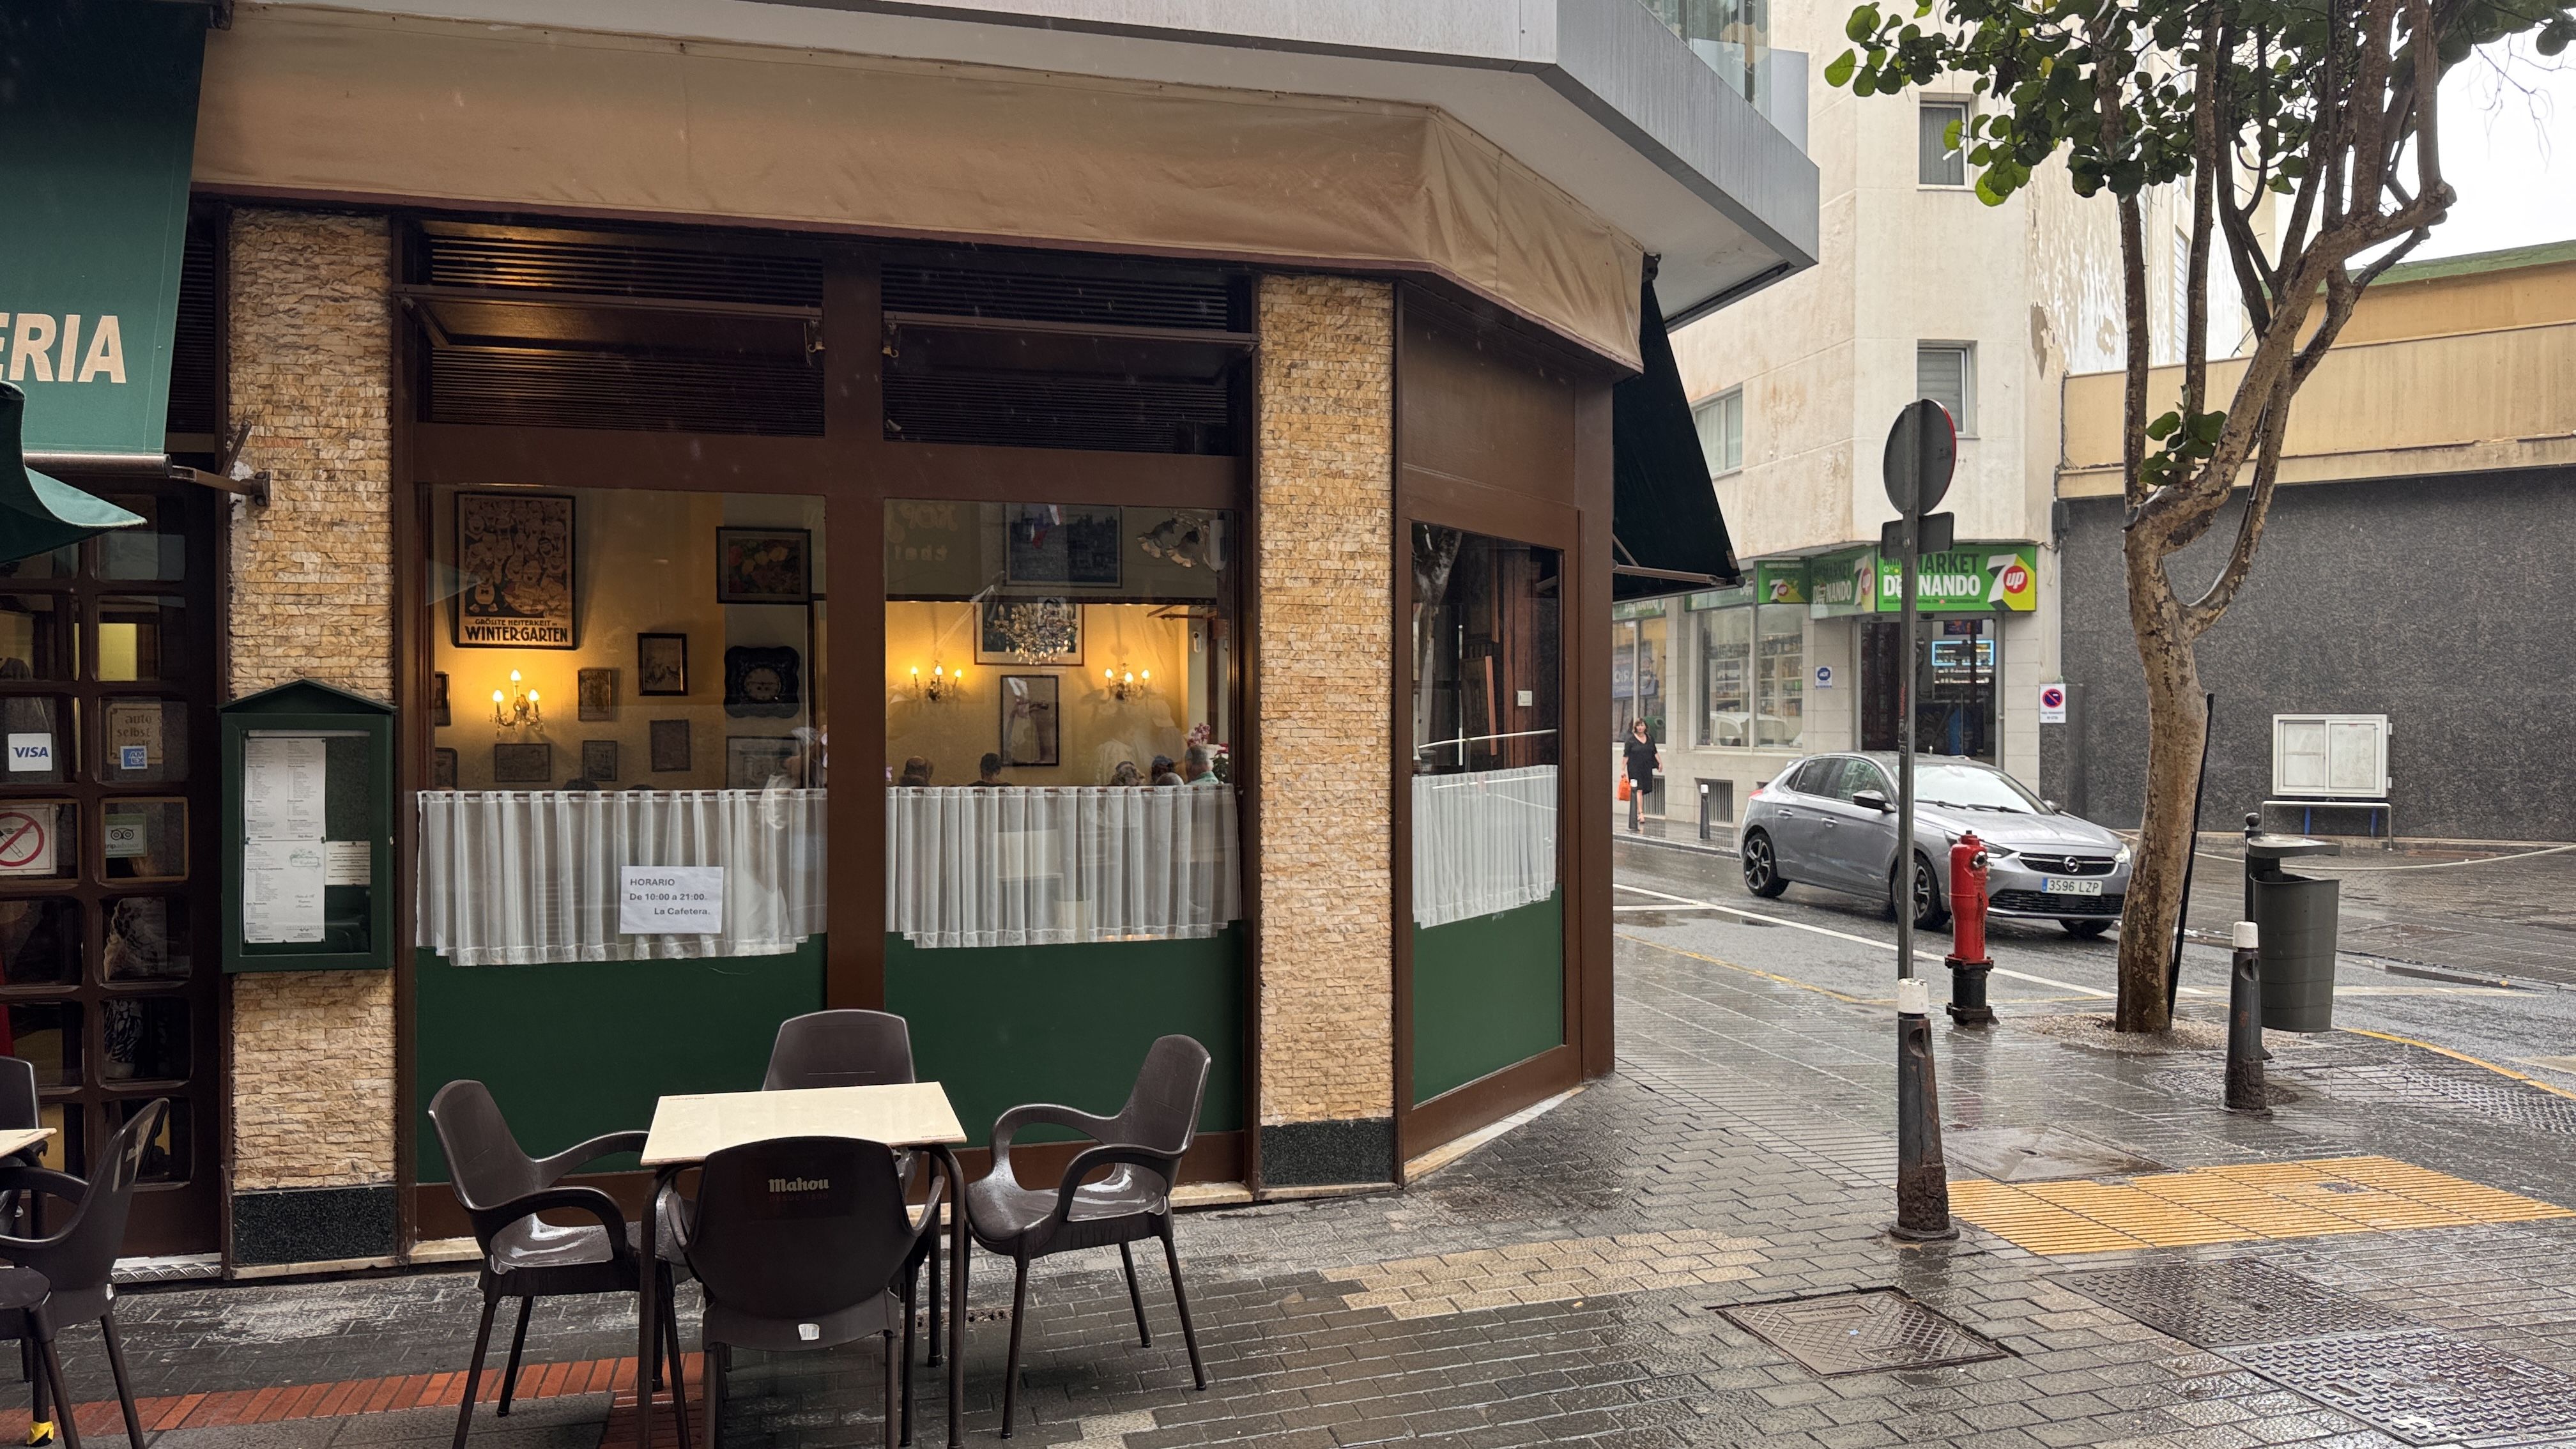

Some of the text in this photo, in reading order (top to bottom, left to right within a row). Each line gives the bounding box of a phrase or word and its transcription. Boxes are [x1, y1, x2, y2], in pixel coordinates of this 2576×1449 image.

[1919, 574, 1981, 597] NANDO
[125, 715, 152, 724] auto
[117, 727, 151, 737] selbst
[12, 746, 49, 758] VISA
[2049, 880, 2099, 893] 3596 LZP
[668, 907, 710, 916] Cafetera.
[768, 1177, 829, 1192] Mahou
